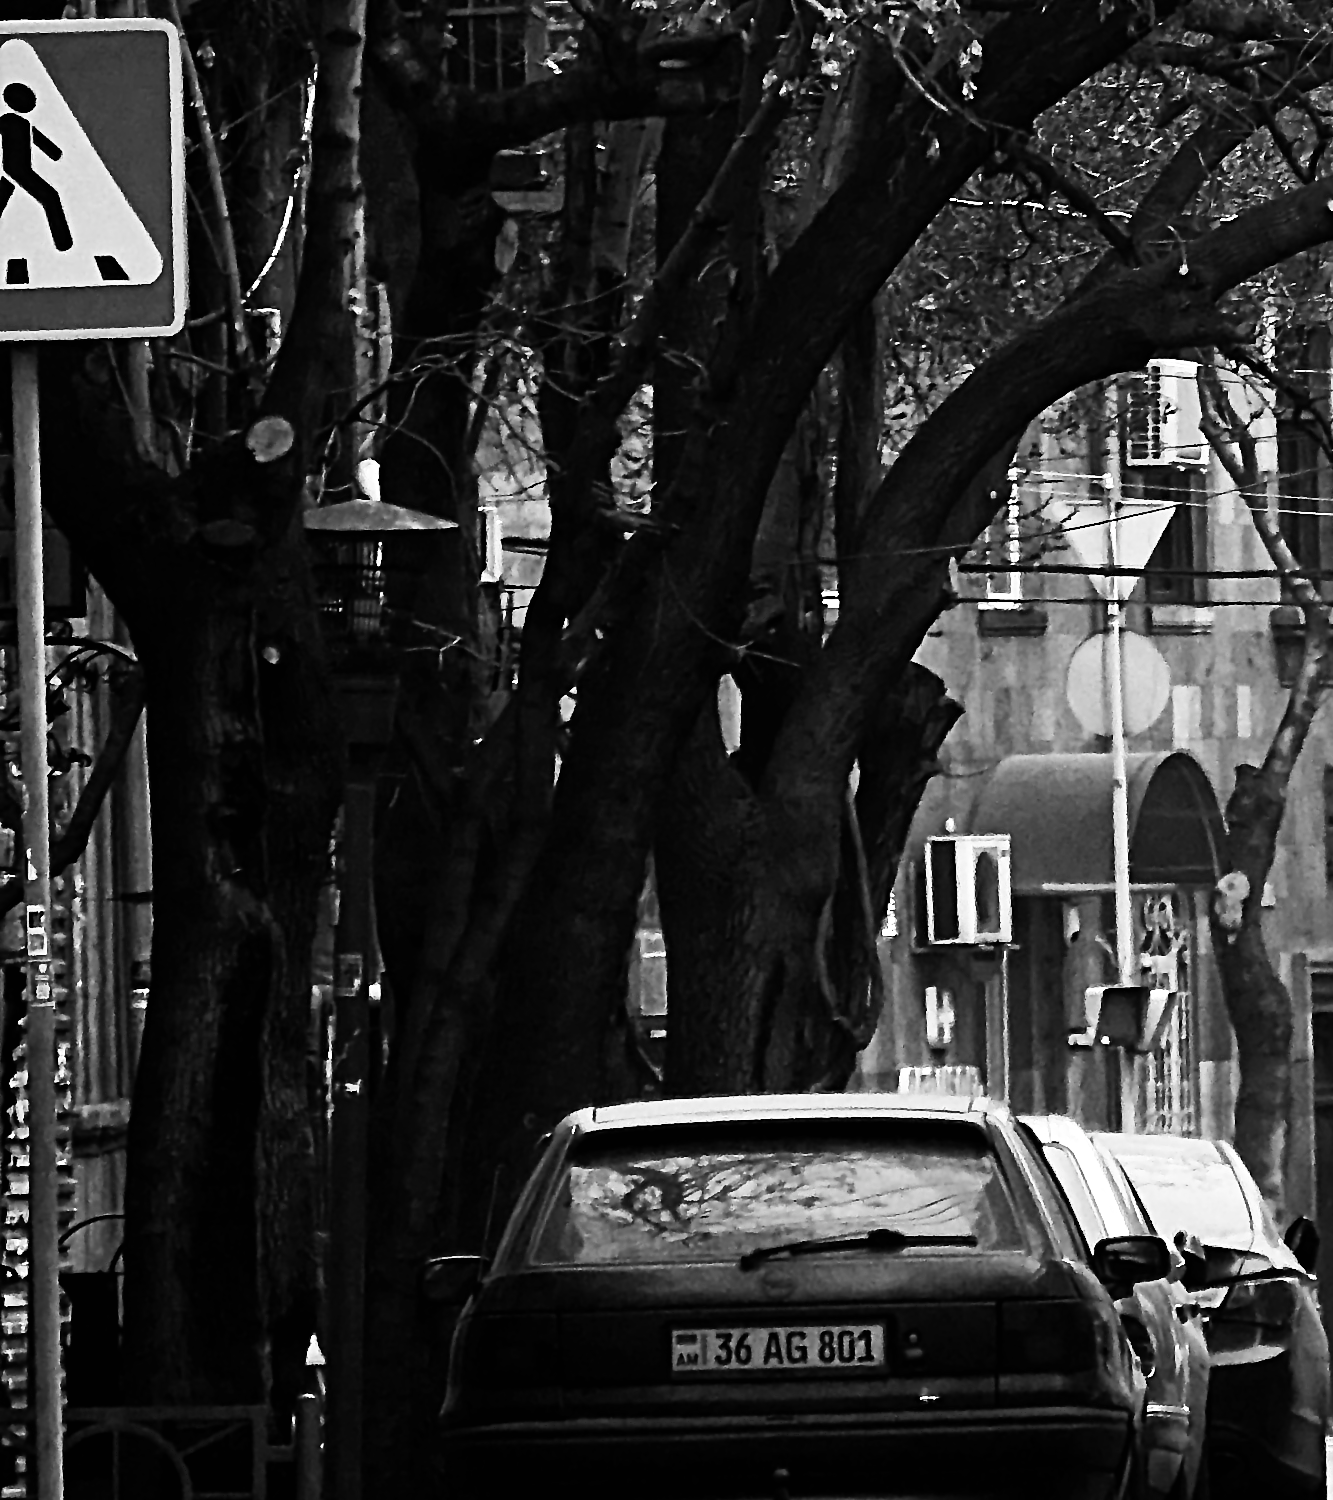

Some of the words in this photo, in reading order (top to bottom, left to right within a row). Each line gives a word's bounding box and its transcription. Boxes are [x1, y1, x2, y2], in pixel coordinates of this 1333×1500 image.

[714, 1332, 751, 1366] 36
[763, 1331, 808, 1366] AG
[818, 1330, 875, 1364] 801
